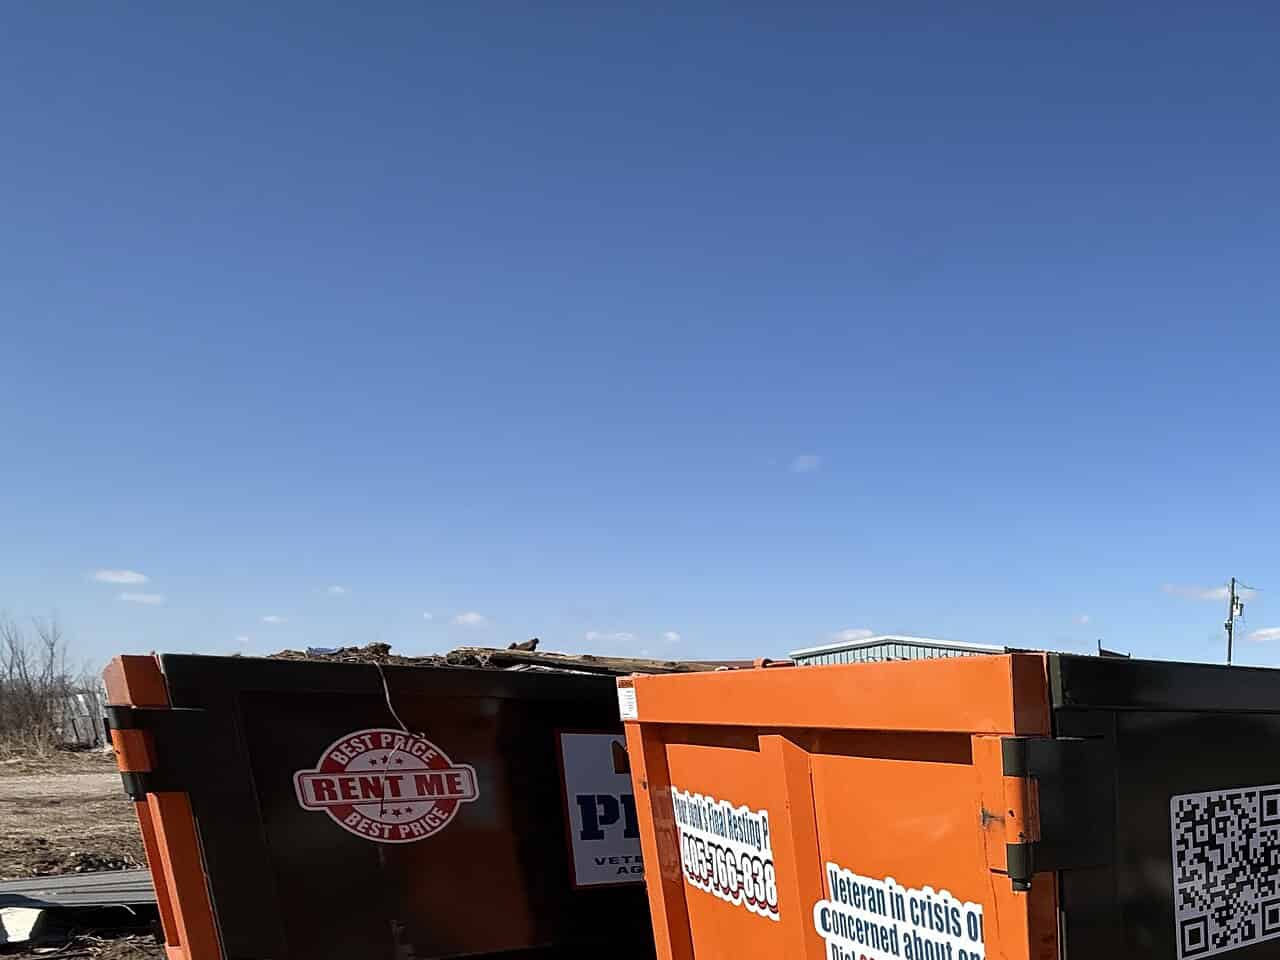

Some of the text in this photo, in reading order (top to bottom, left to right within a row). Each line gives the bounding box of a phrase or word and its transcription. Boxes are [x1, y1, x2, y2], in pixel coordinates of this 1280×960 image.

[330, 733, 438, 766] BEST PRICE
[311, 773, 464, 801] RENT ME
[345, 807, 449, 839] BEST PRICE
[708, 803, 728, 839] Final
[727, 807, 761, 851] Resting
[829, 869, 887, 917] Veteran
[889, 886, 906, 922] in
[909, 890, 962, 938] crisis
